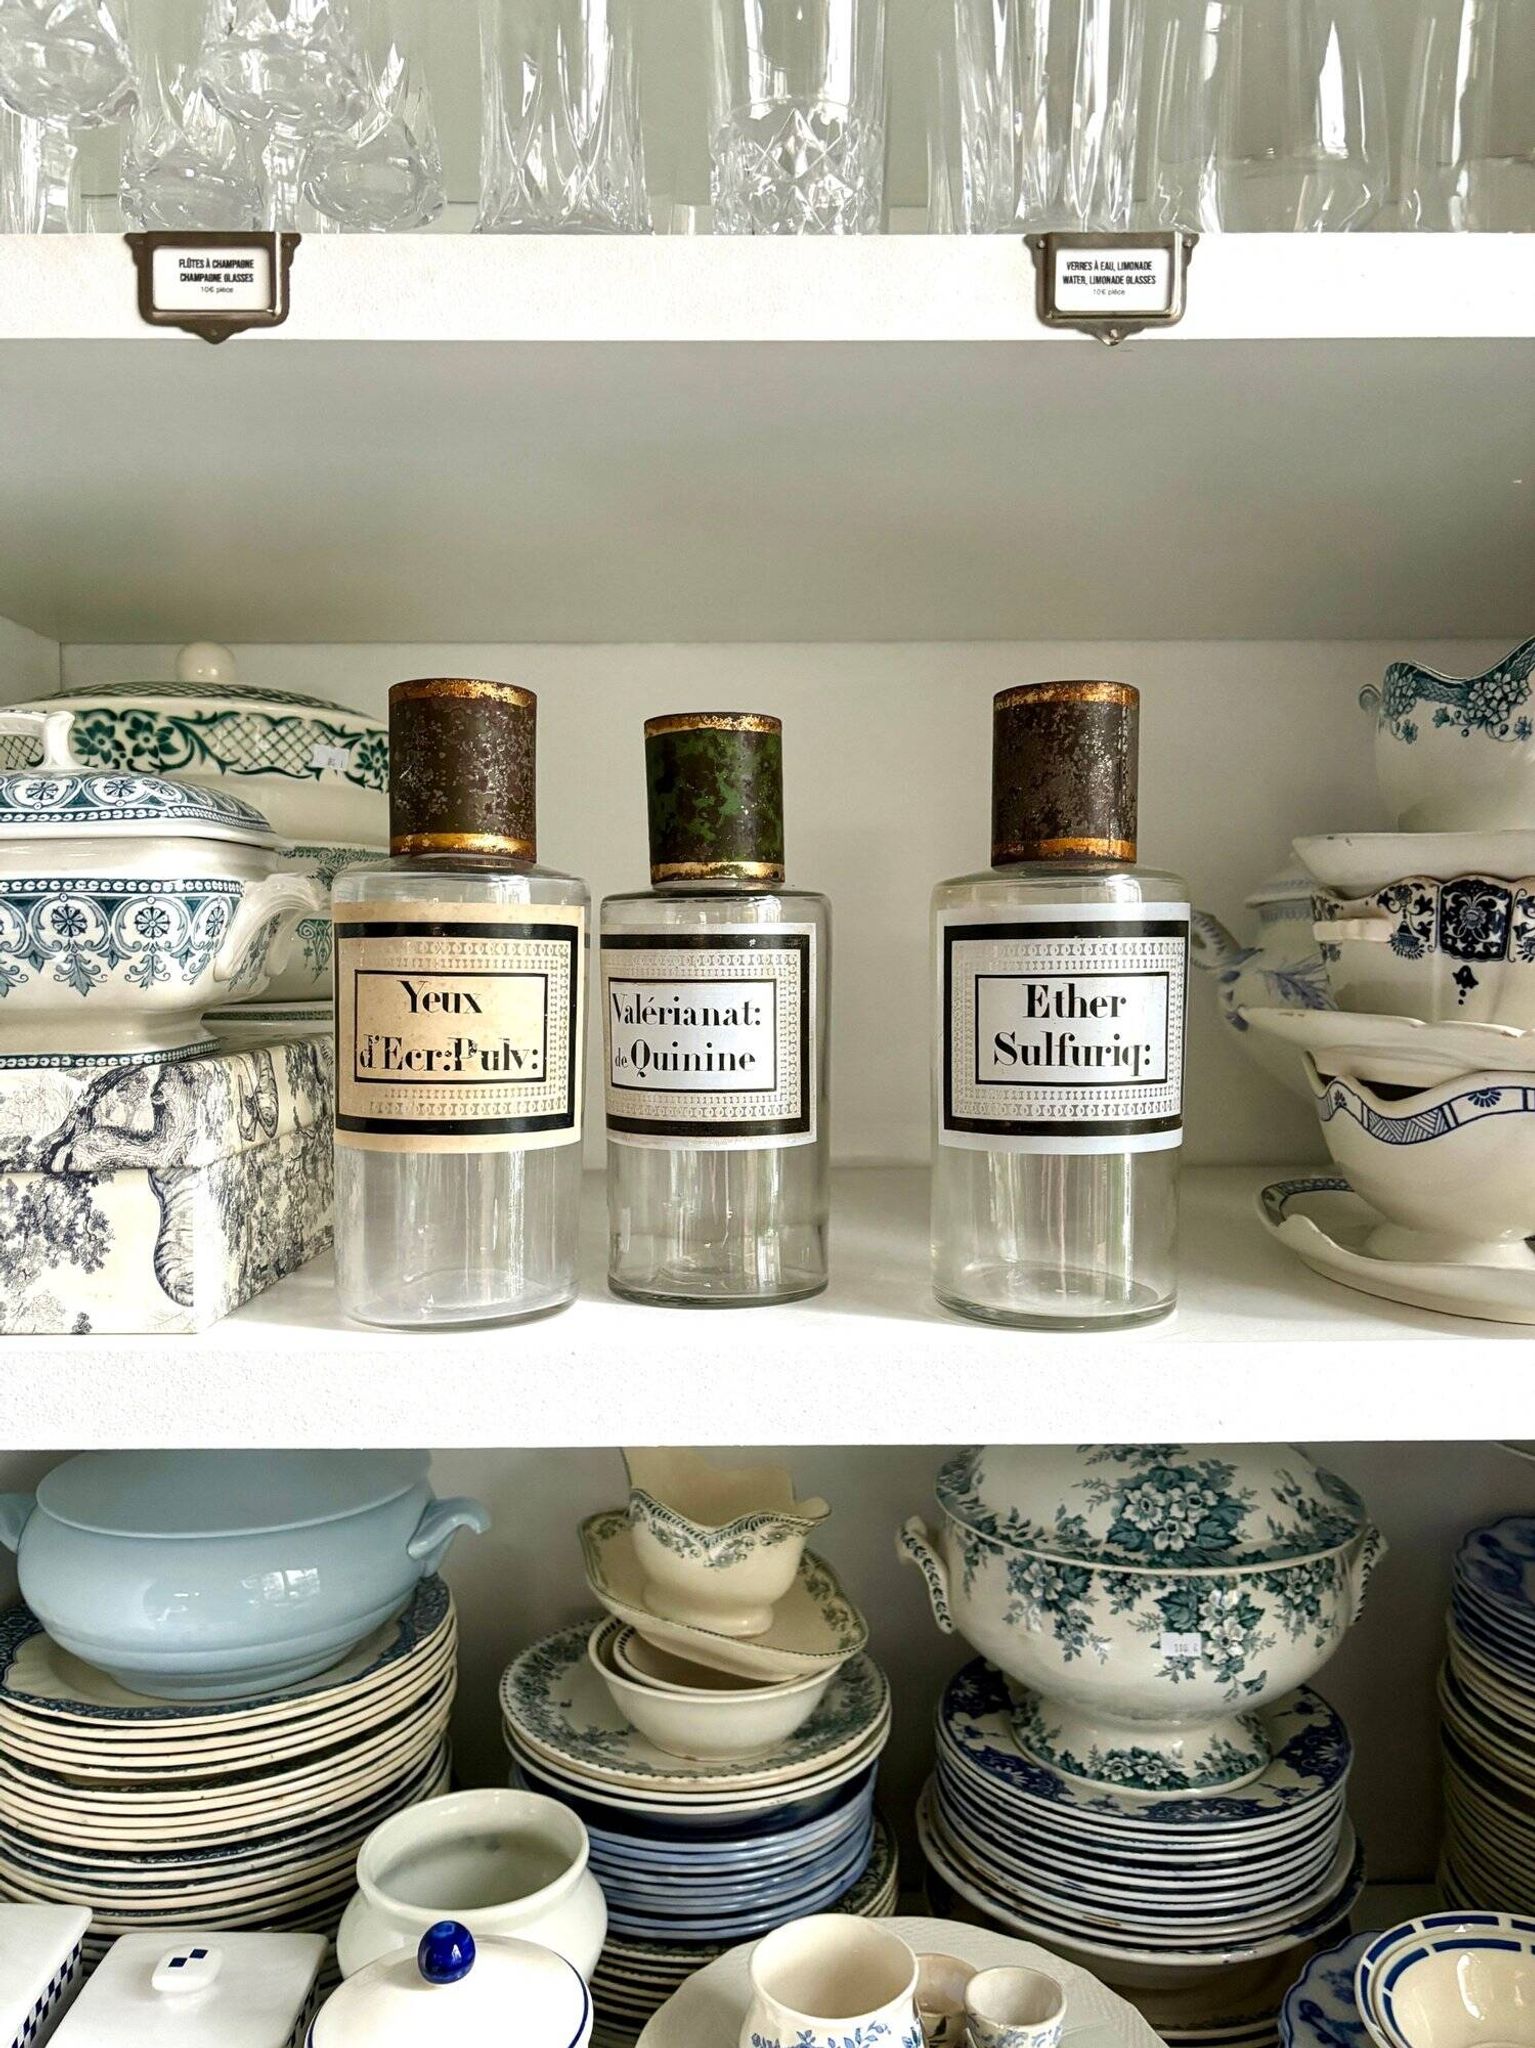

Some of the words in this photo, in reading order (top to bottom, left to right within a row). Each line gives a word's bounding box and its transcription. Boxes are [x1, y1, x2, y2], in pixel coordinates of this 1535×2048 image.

[178, 257, 204, 268] FLÛTES
[206, 257, 210, 268] À
[212, 259, 254, 268] CHAMPAGNE
[180, 273, 221, 282] CHAMPAGNE
[223, 273, 253, 282] GLASSES
[1066, 261, 1092, 271] VERRES
[1094, 260, 1099, 271] À
[1100, 261, 1116, 271] EAU,
[1117, 261, 1152, 271] LIMONADE
[1062, 275, 1088, 285] WATER,
[1089, 275, 1124, 284] LIMONADE
[1125, 275, 1156, 284] GLASSES
[397, 980, 482, 1014] Yeux
[612, 993, 761, 1027] Valérianat:
[1021, 982, 1127, 1018] Ether
[614, 1047, 629, 1069] de
[630, 1038, 756, 1078] Quinine
[993, 1030, 1151, 1077] Sulfuriq:
